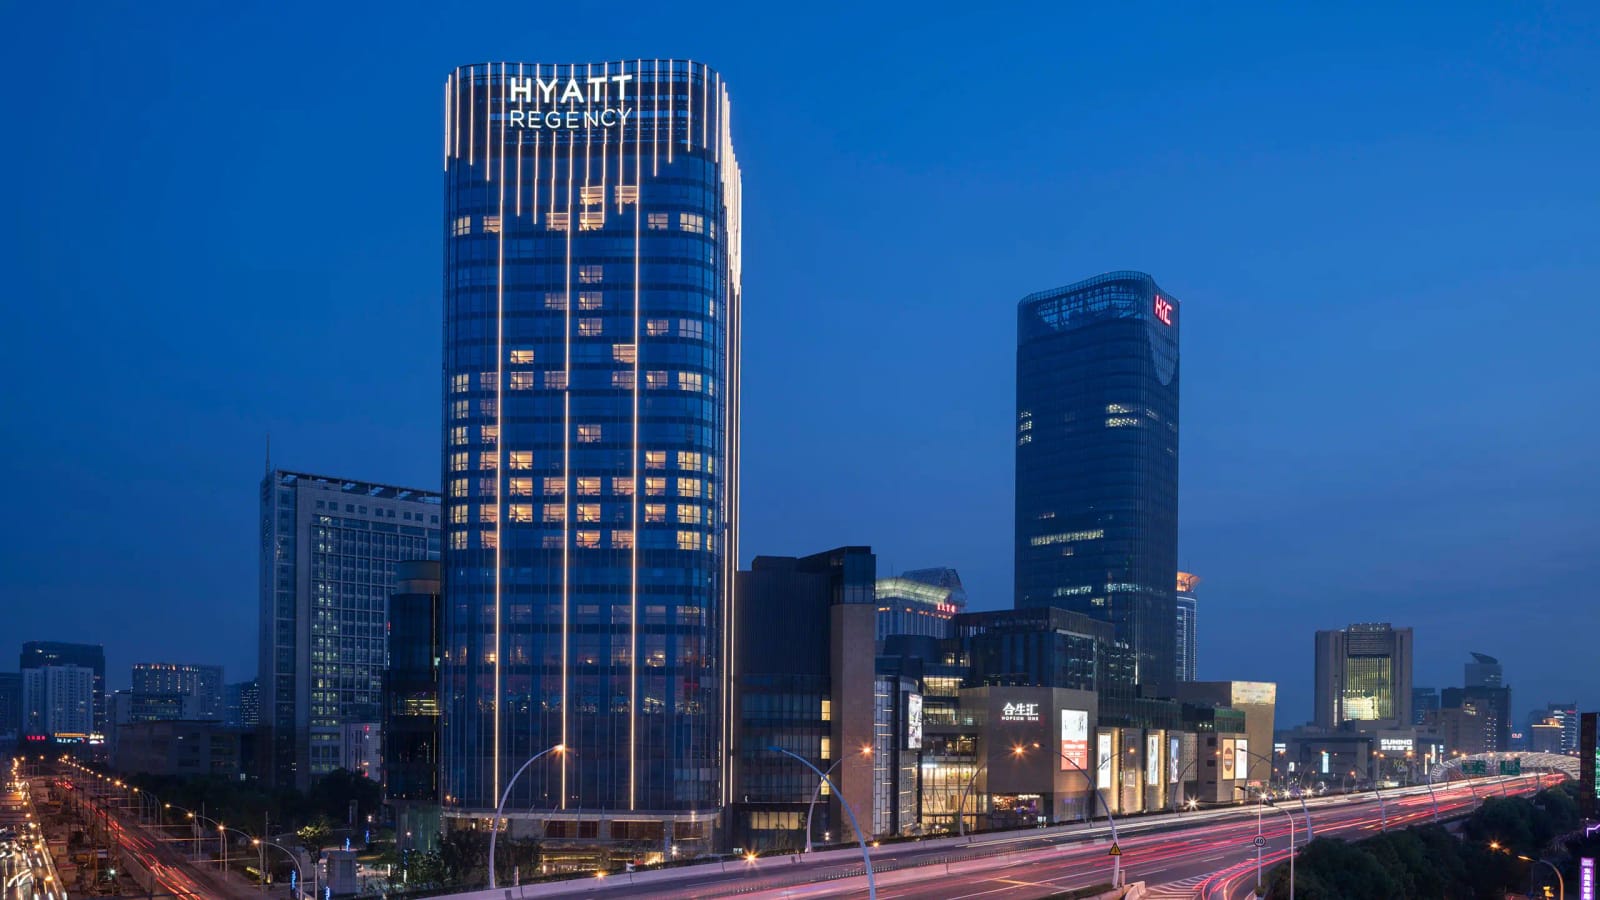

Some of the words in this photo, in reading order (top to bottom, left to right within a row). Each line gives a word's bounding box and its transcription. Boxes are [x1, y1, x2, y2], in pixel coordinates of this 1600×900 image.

[510, 75, 632, 103] HYATT
[510, 107, 632, 128] REGENCY
[1002, 702, 1039, 716] 合生汇
